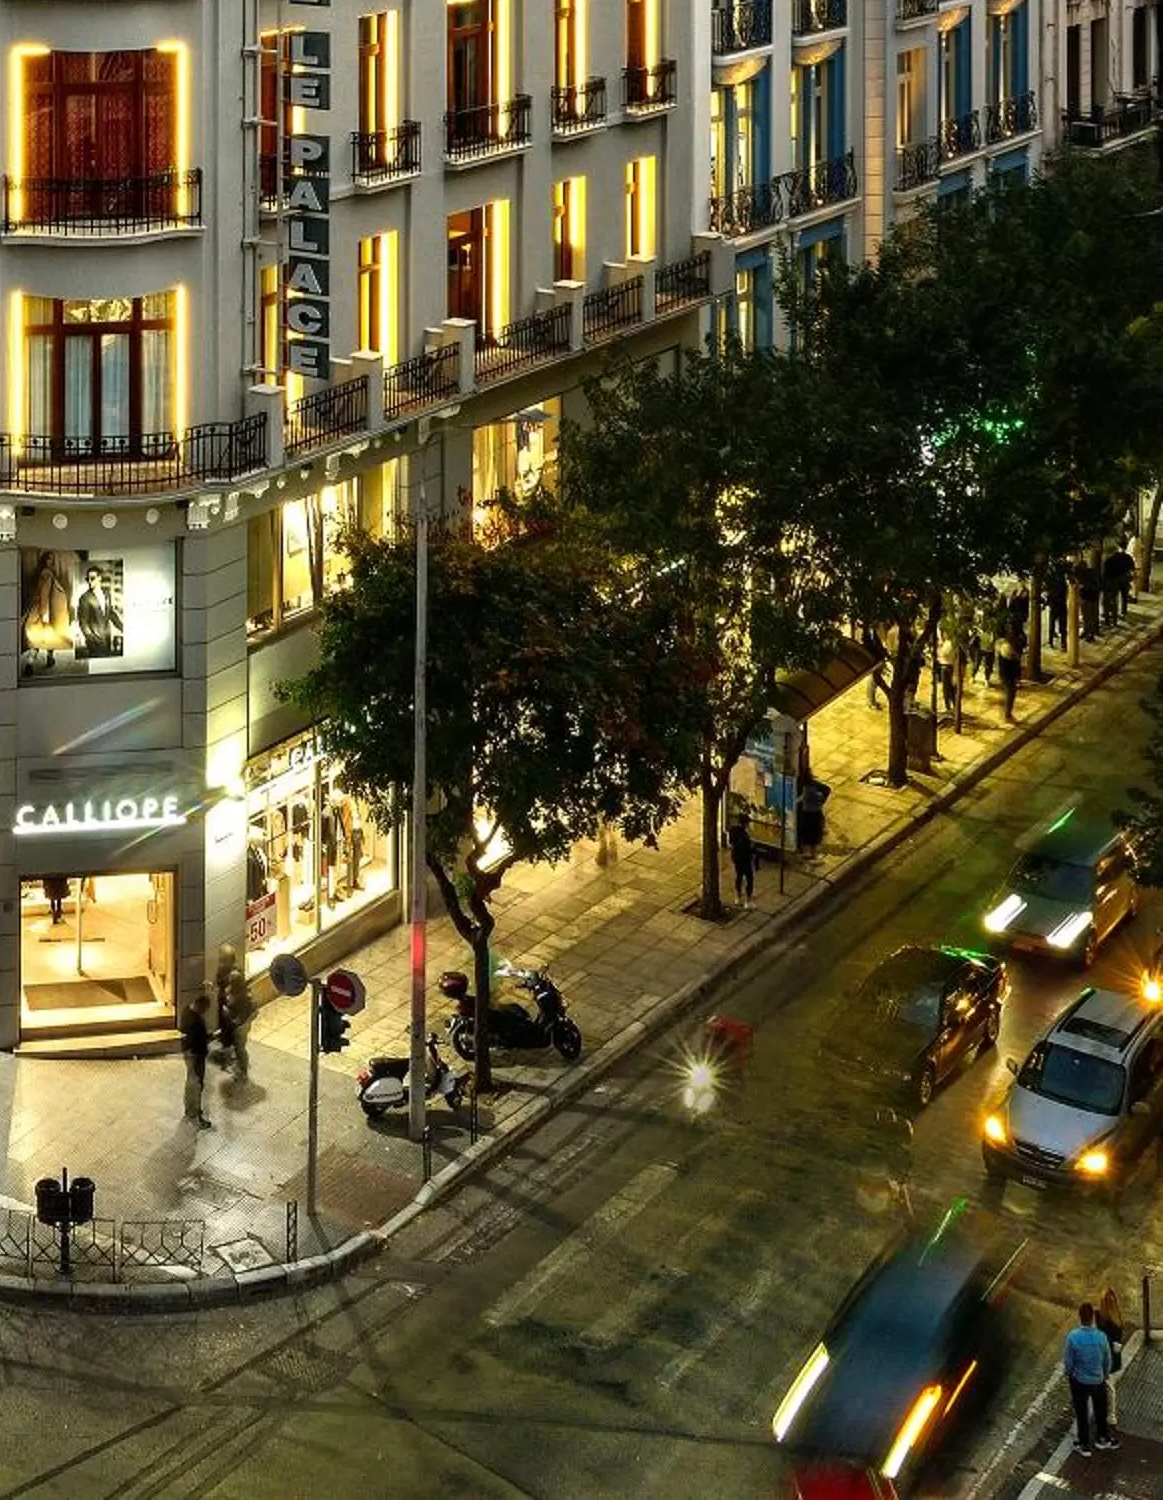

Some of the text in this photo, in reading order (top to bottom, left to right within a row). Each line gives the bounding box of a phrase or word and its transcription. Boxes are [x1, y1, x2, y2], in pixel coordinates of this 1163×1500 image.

[291, 35, 320, 107] LE
[287, 138, 323, 378] PALACE
[15, 795, 179, 828] CALLIOPE
[245, 917, 271, 942] -50
